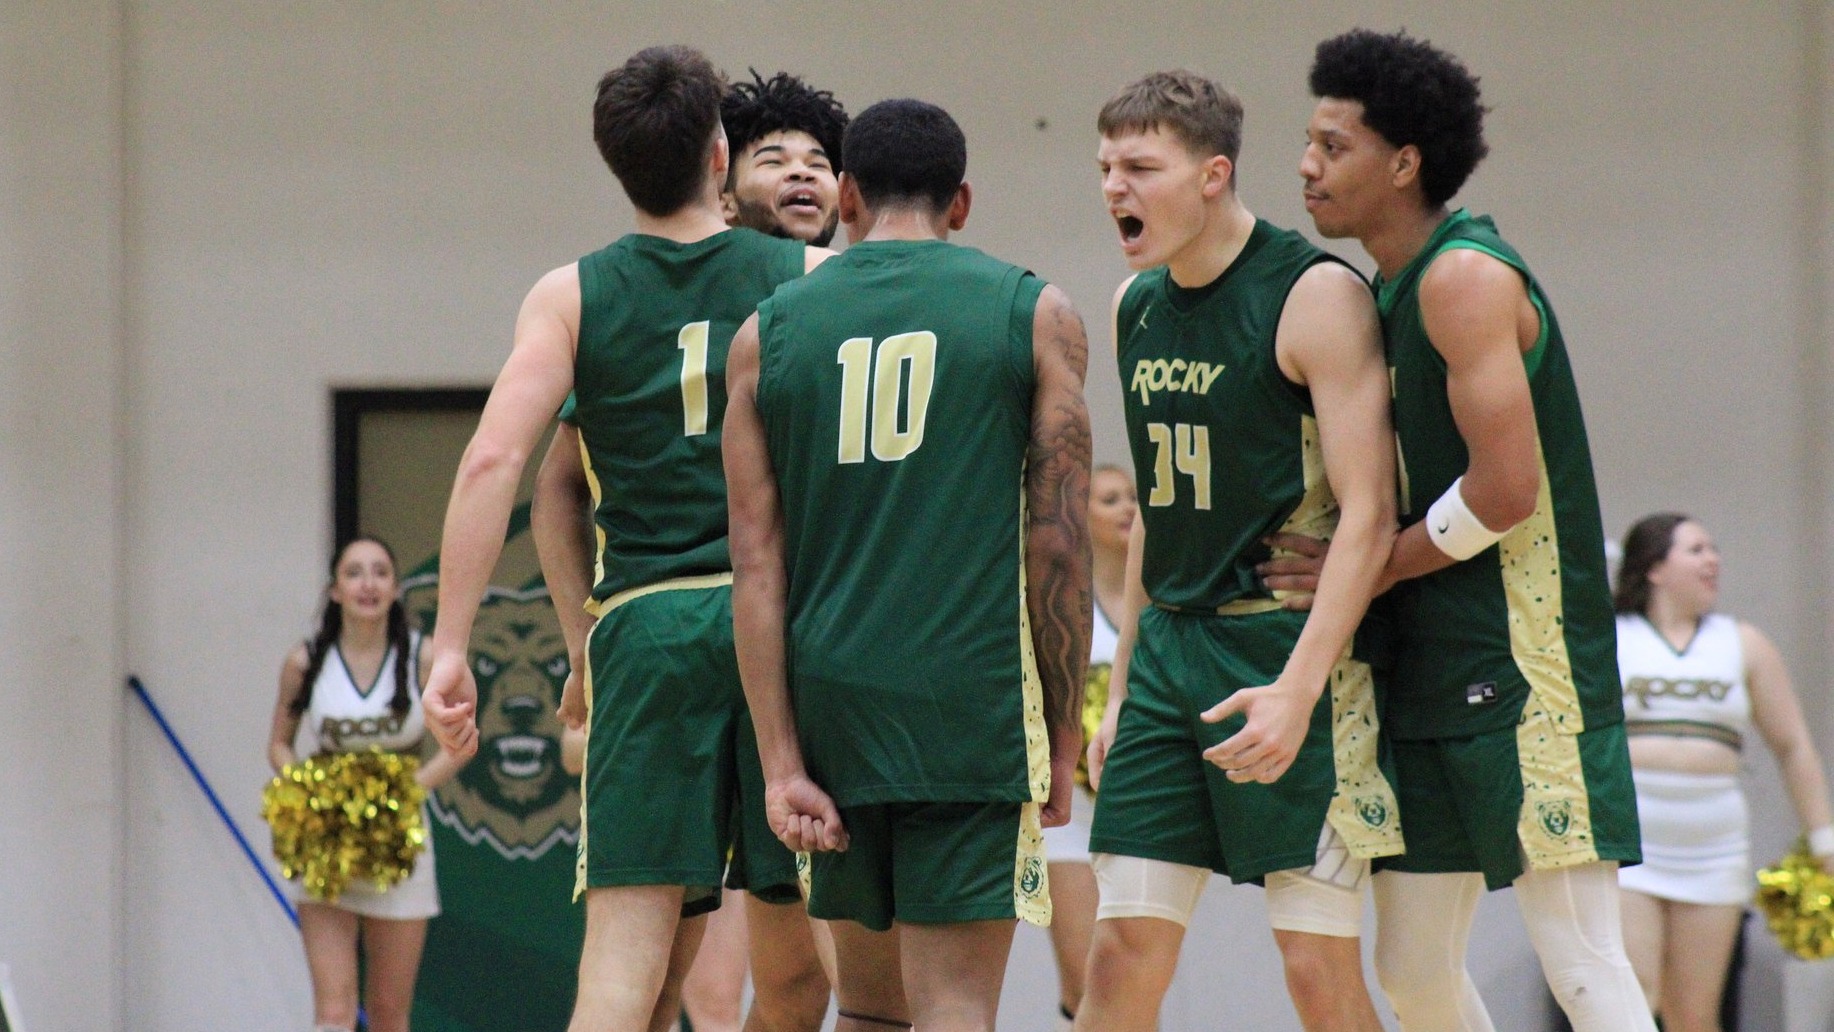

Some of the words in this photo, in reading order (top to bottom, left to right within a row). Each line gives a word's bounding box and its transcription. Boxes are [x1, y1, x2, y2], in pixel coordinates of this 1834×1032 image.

[678, 320, 710, 437] 1
[837, 331, 937, 464] 10
[1131, 358, 1226, 406] ROCKY
[1147, 423, 1211, 510] 34
[1624, 676, 1734, 709] ROCKY
